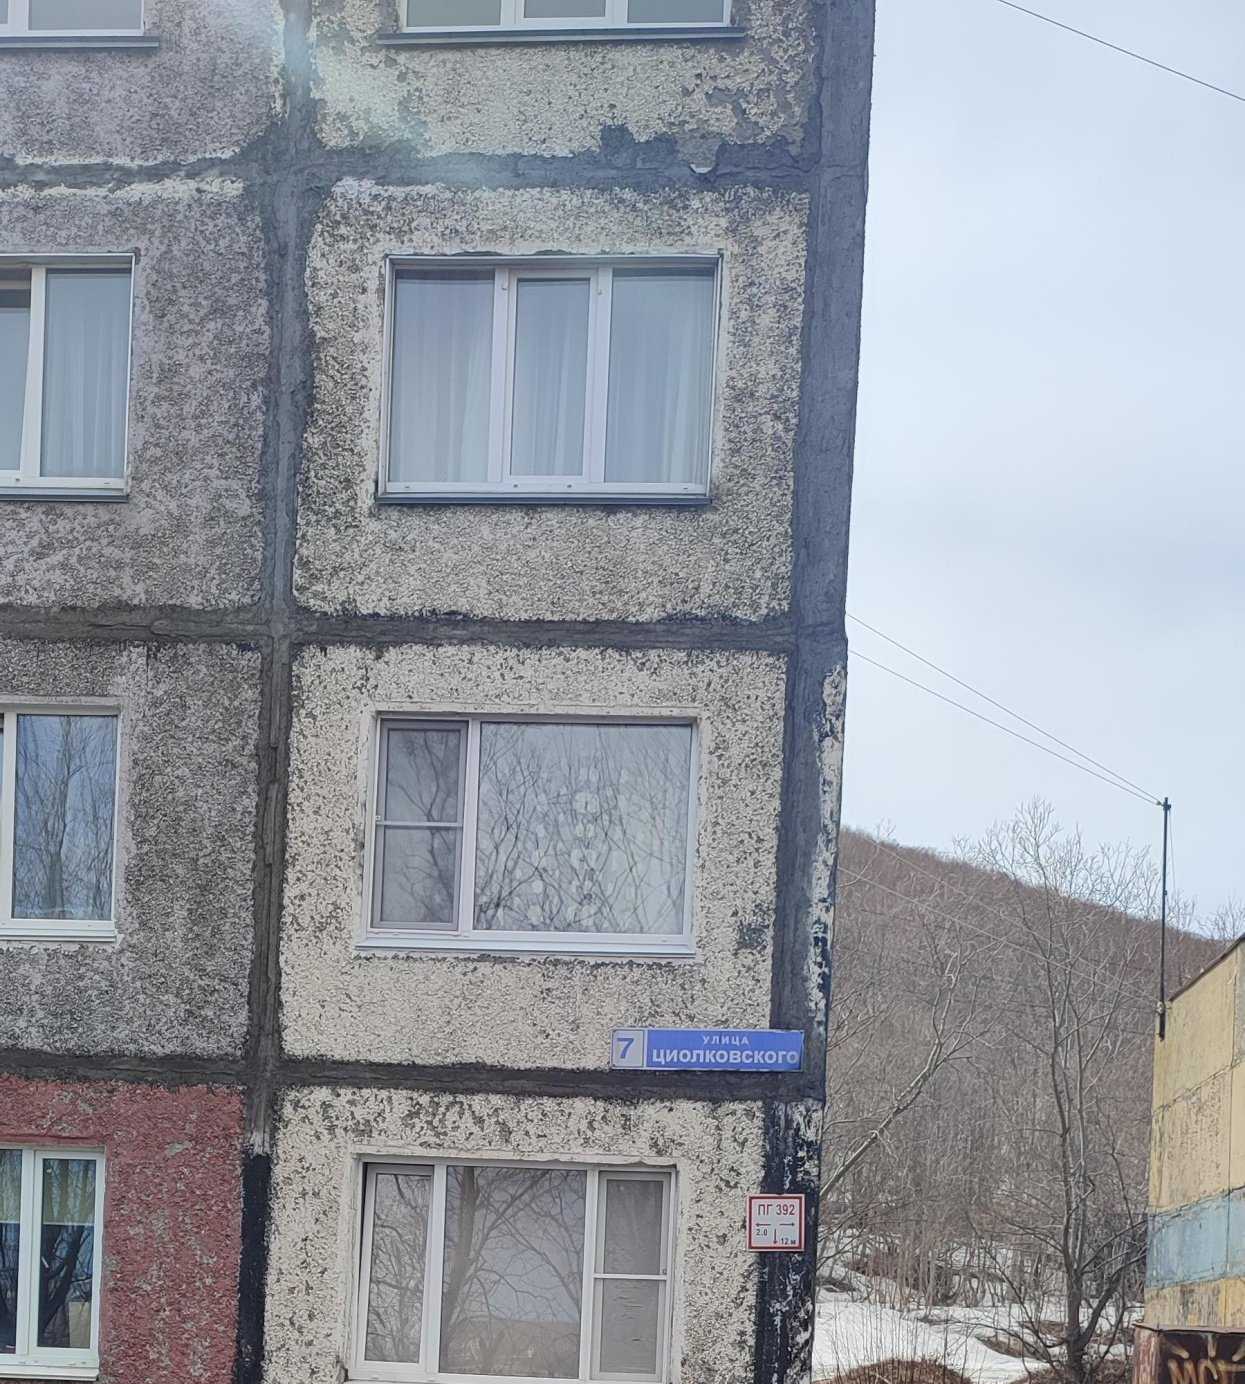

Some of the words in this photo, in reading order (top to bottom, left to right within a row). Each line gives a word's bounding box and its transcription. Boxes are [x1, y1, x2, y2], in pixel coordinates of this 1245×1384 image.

[616, 1037, 634, 1058] 7
[702, 1035, 749, 1046] УЛИЦА
[652, 1049, 799, 1065] ЦИОЛКОВСКОГО
[757, 1203, 773, 1215] ПГ
[775, 1203, 796, 1216] 392
